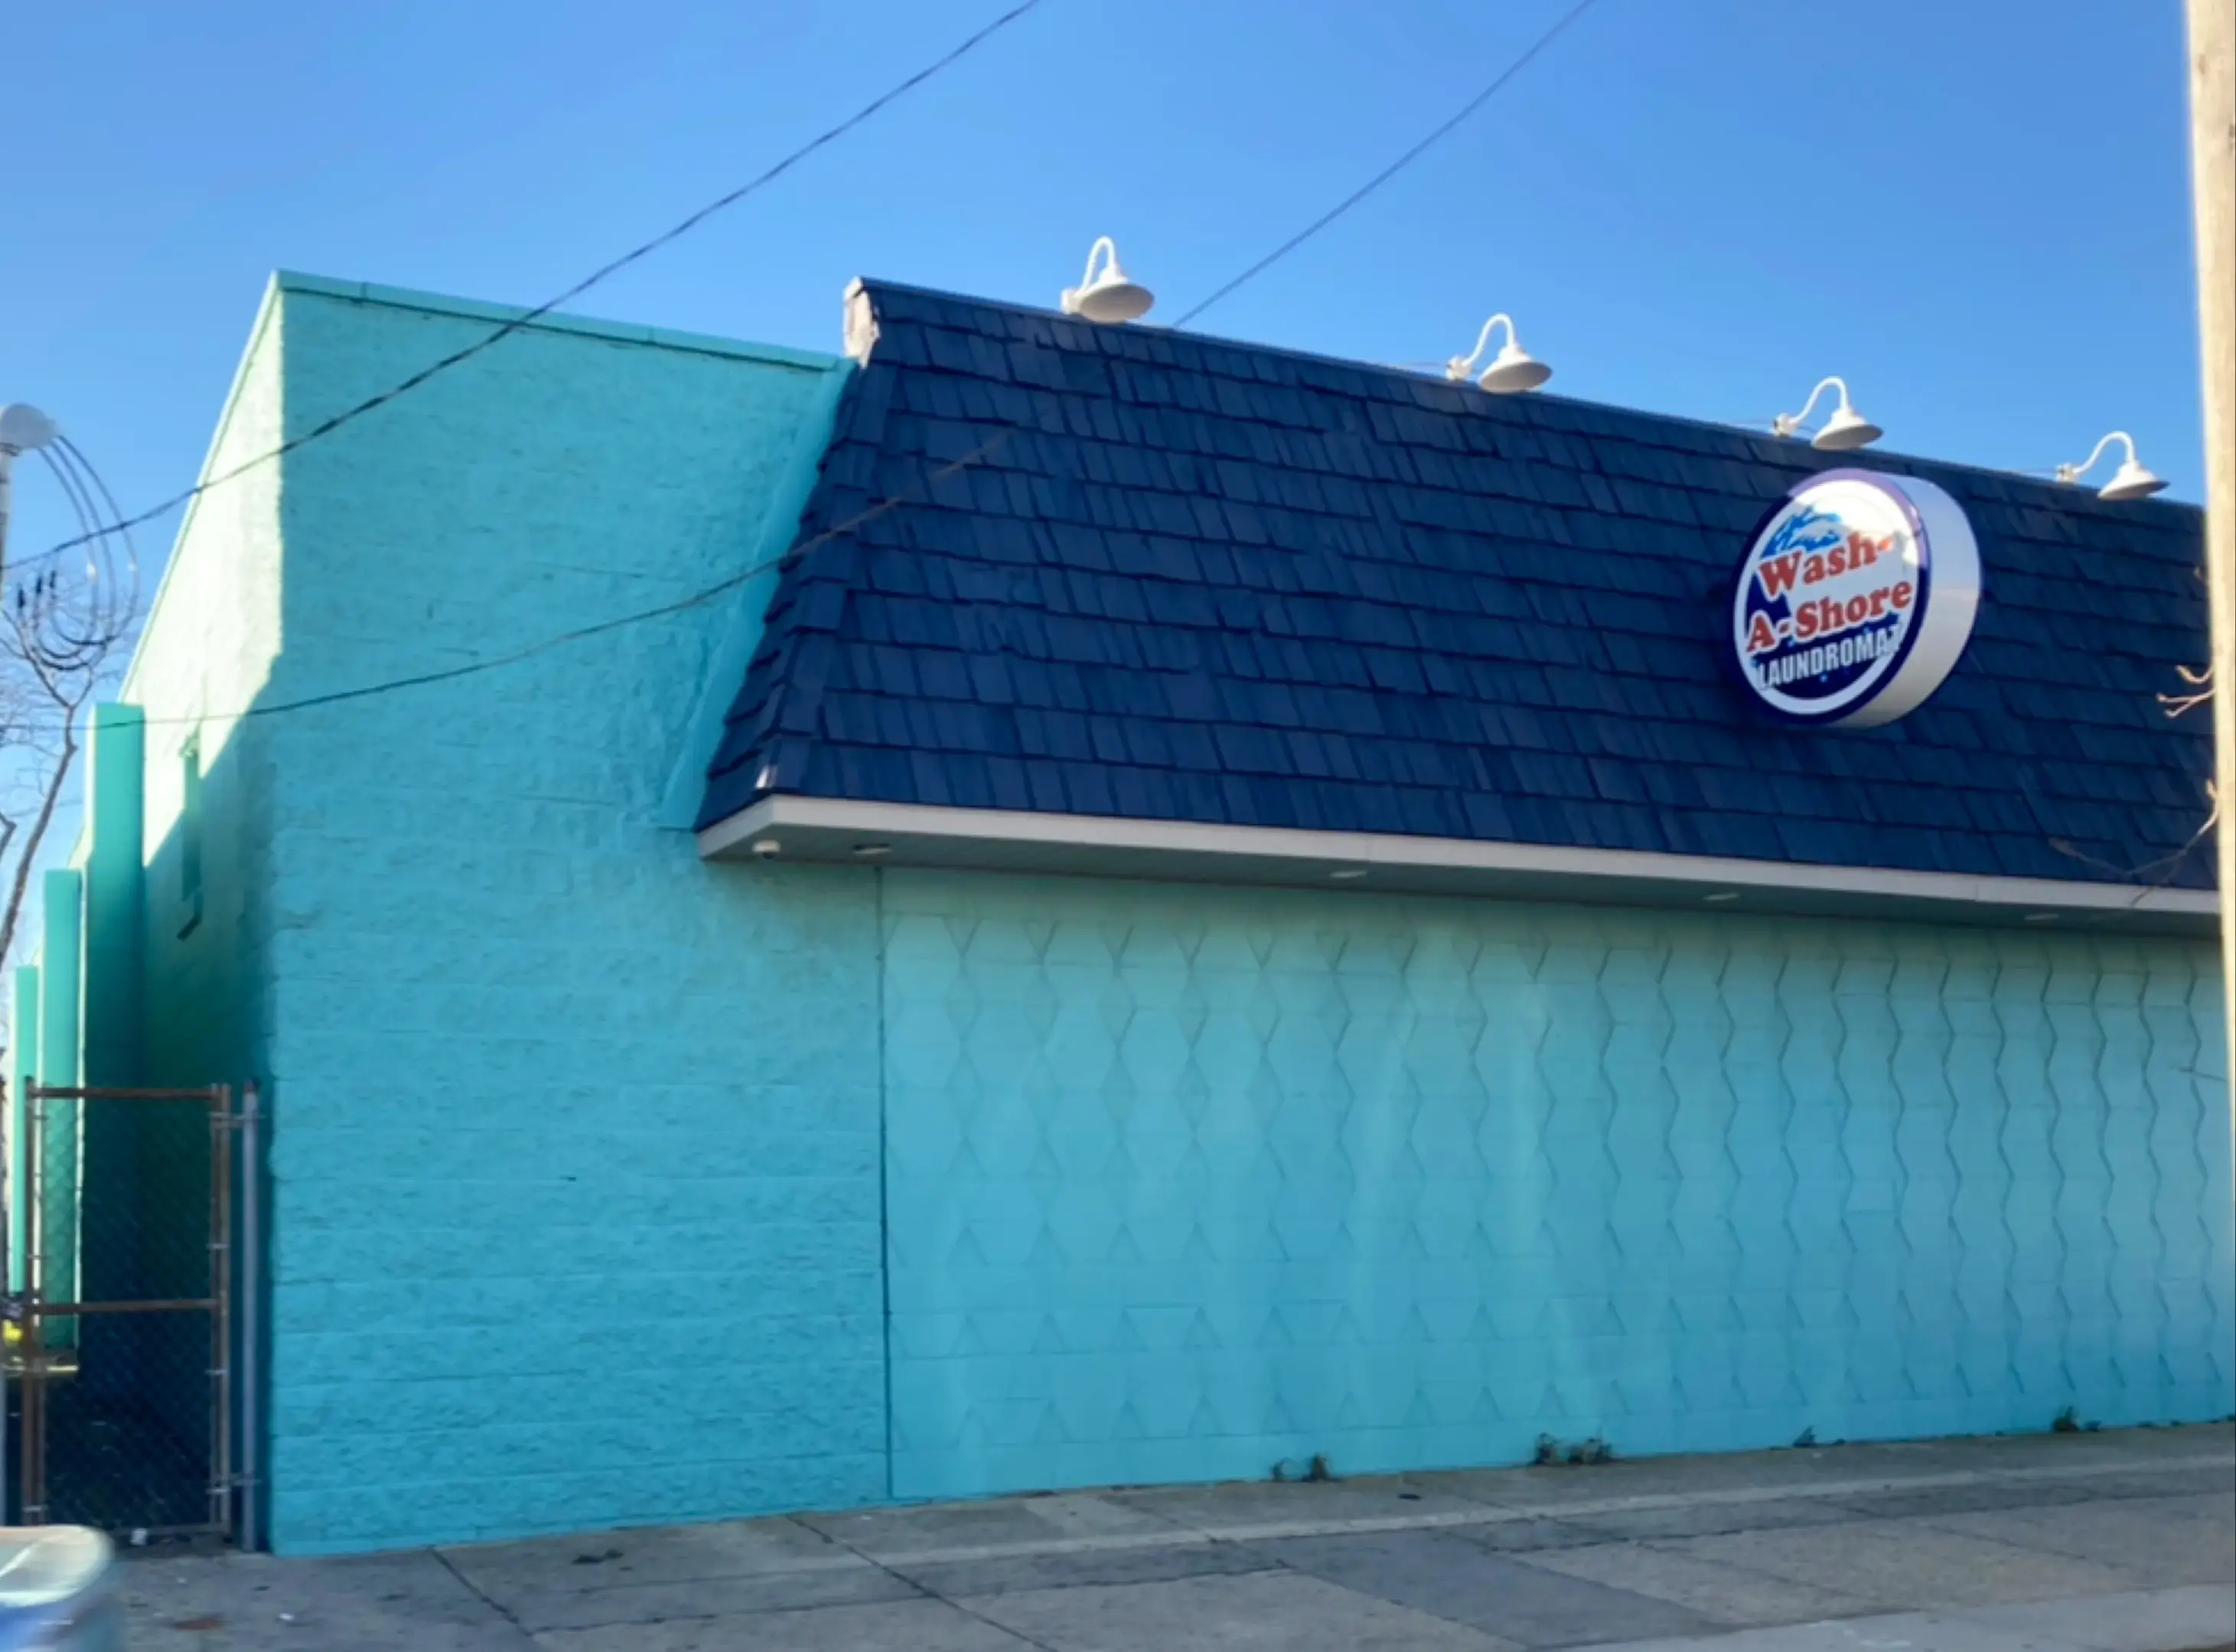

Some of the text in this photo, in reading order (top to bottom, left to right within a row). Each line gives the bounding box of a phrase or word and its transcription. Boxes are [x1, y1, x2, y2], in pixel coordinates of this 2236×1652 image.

[1759, 532, 1892, 596] Wash-
[1747, 582, 1912, 653] A-Shore
[1758, 625, 1902, 689] LAUNDROMAT
